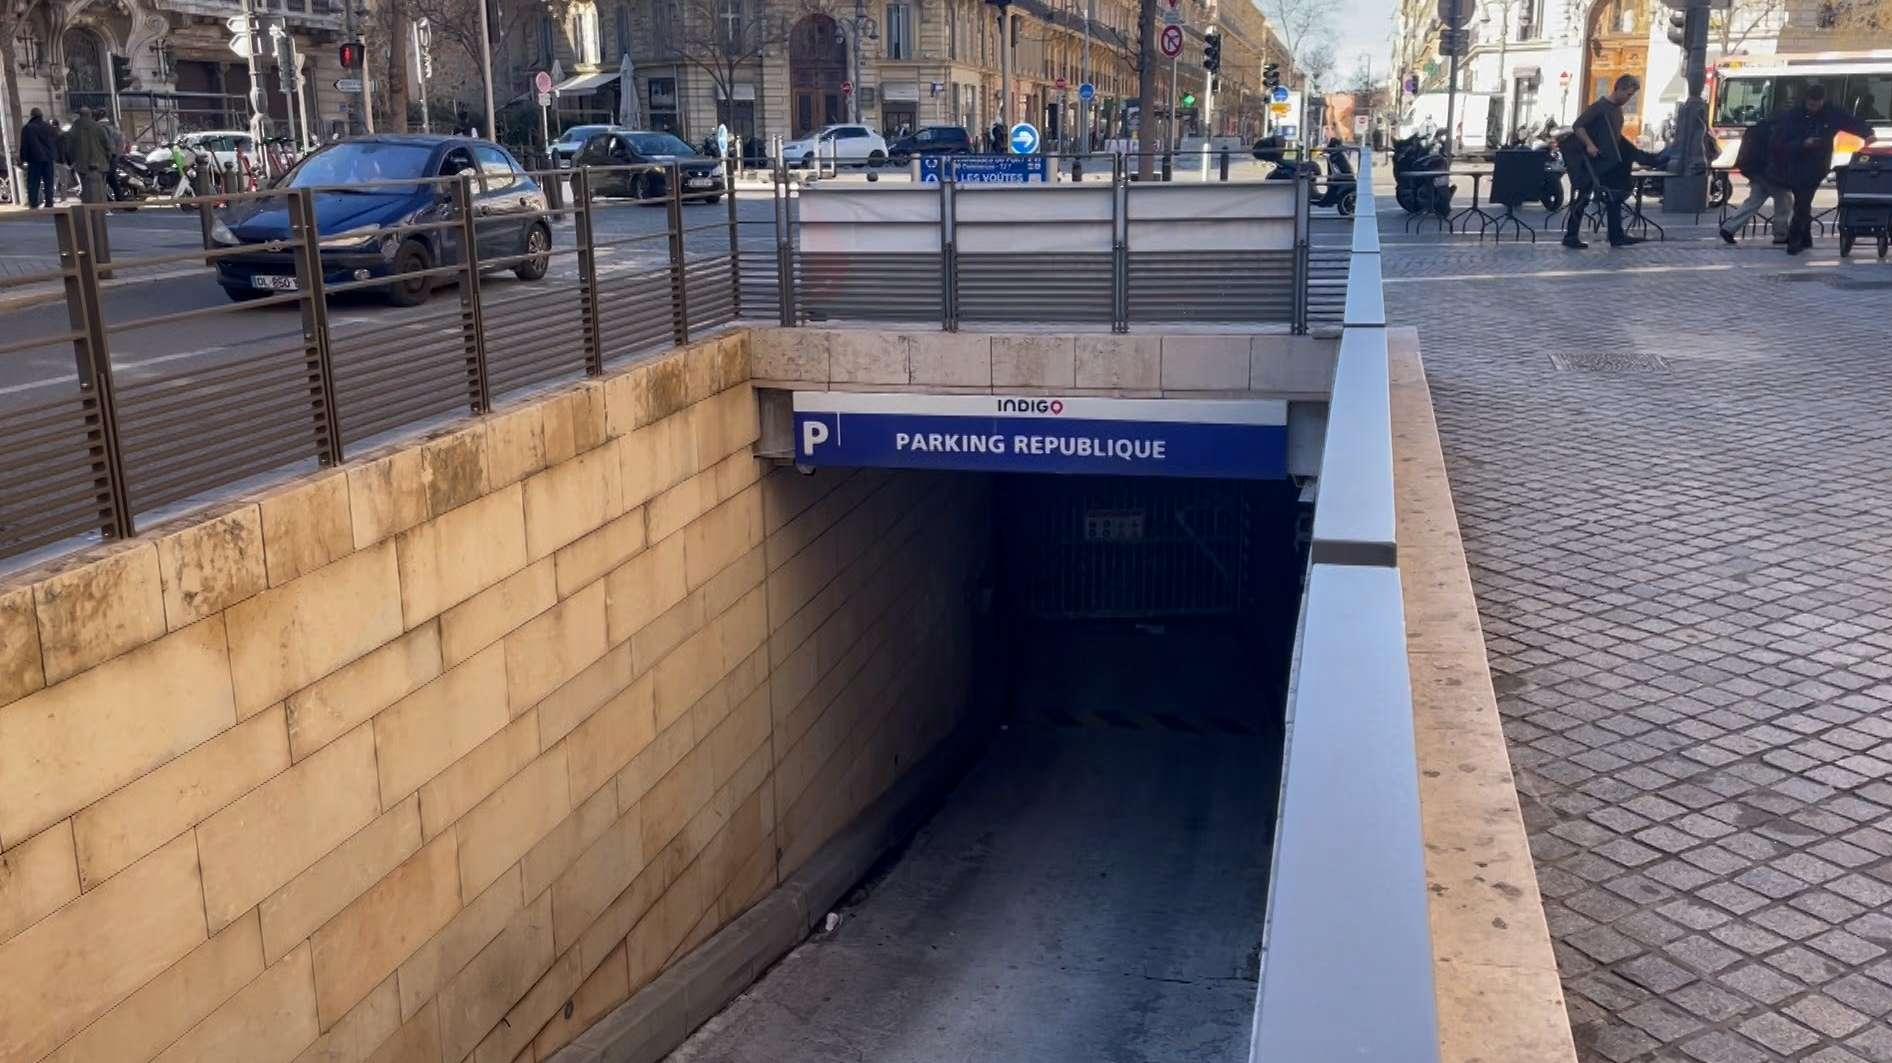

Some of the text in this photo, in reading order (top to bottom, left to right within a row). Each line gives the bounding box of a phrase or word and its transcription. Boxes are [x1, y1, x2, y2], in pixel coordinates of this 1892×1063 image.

[997, 399, 1063, 415] INDIGO
[802, 420, 829, 455] P
[896, 433, 1166, 460] PARKING REPUBLIQUE
